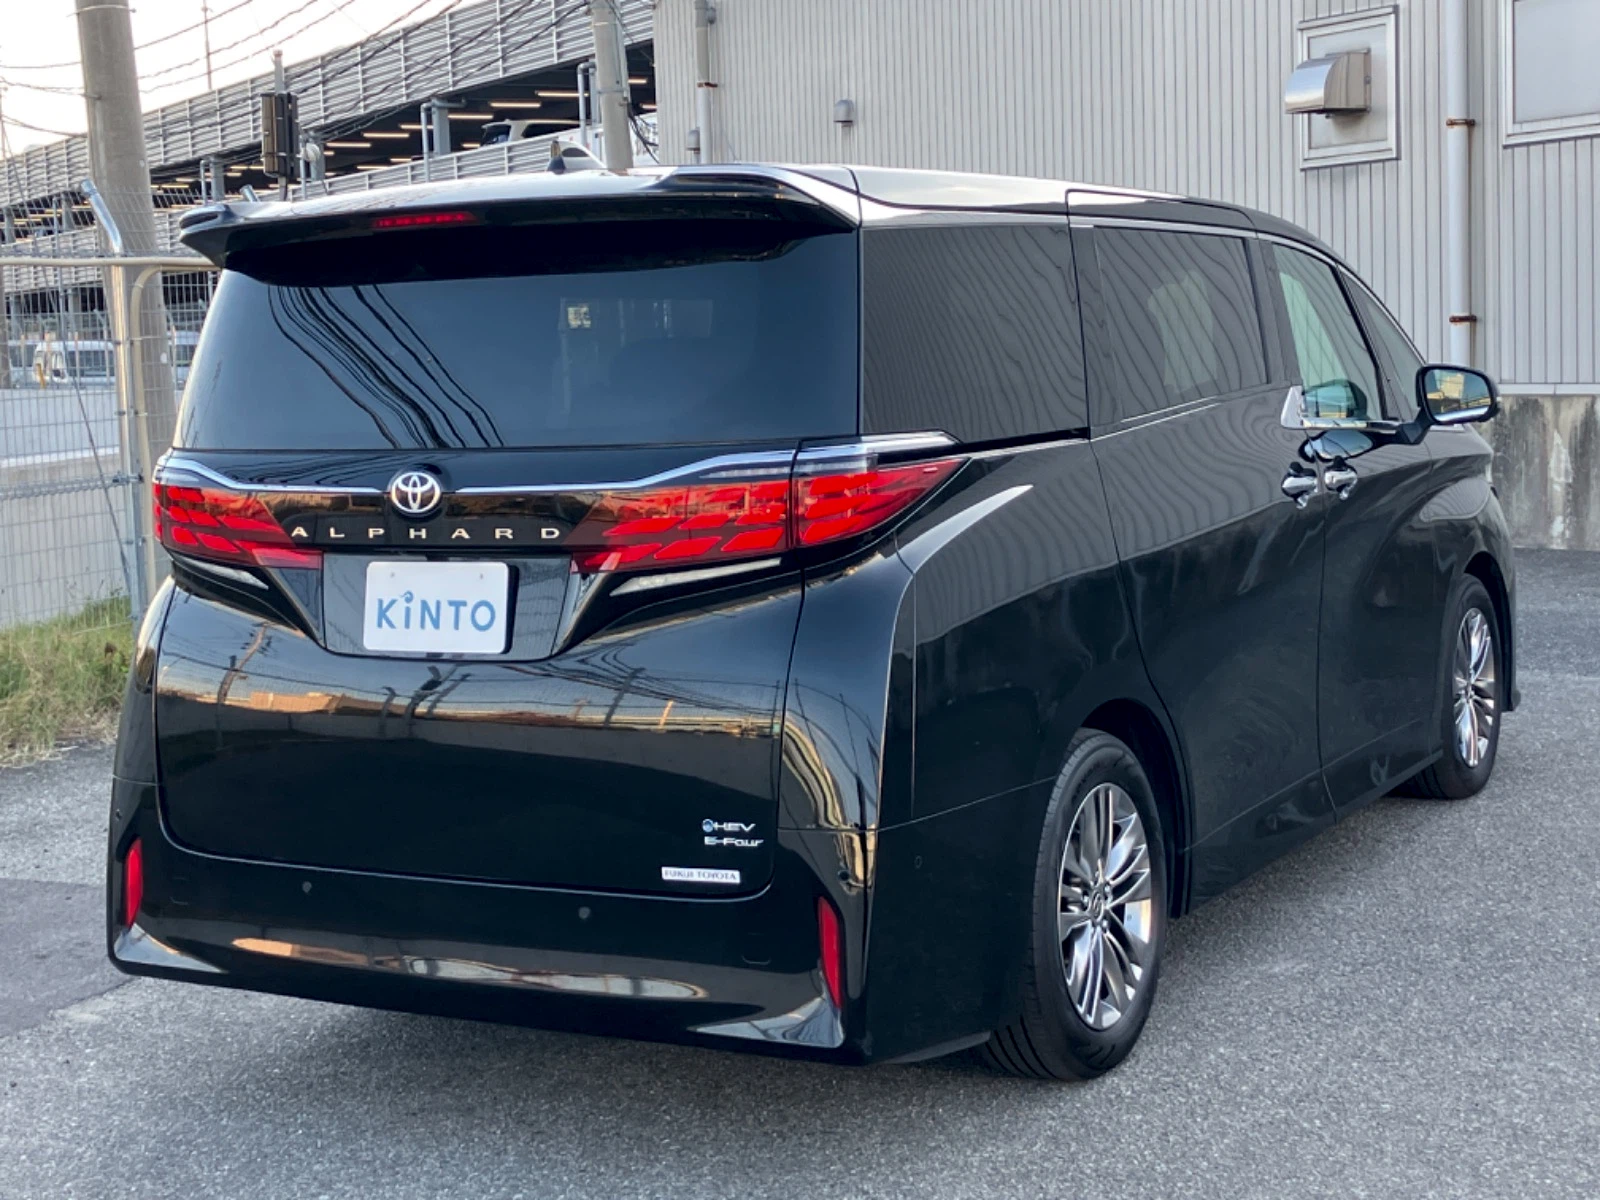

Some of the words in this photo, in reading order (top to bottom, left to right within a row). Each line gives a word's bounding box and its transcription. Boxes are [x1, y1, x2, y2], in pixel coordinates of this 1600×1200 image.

[291, 526, 560, 539] ALPHARD
[714, 821, 756, 832] HEV
[704, 836, 764, 846] E-Four
[664, 869, 695, 878] FUKUI
[697, 871, 737, 880] TOYOTA
